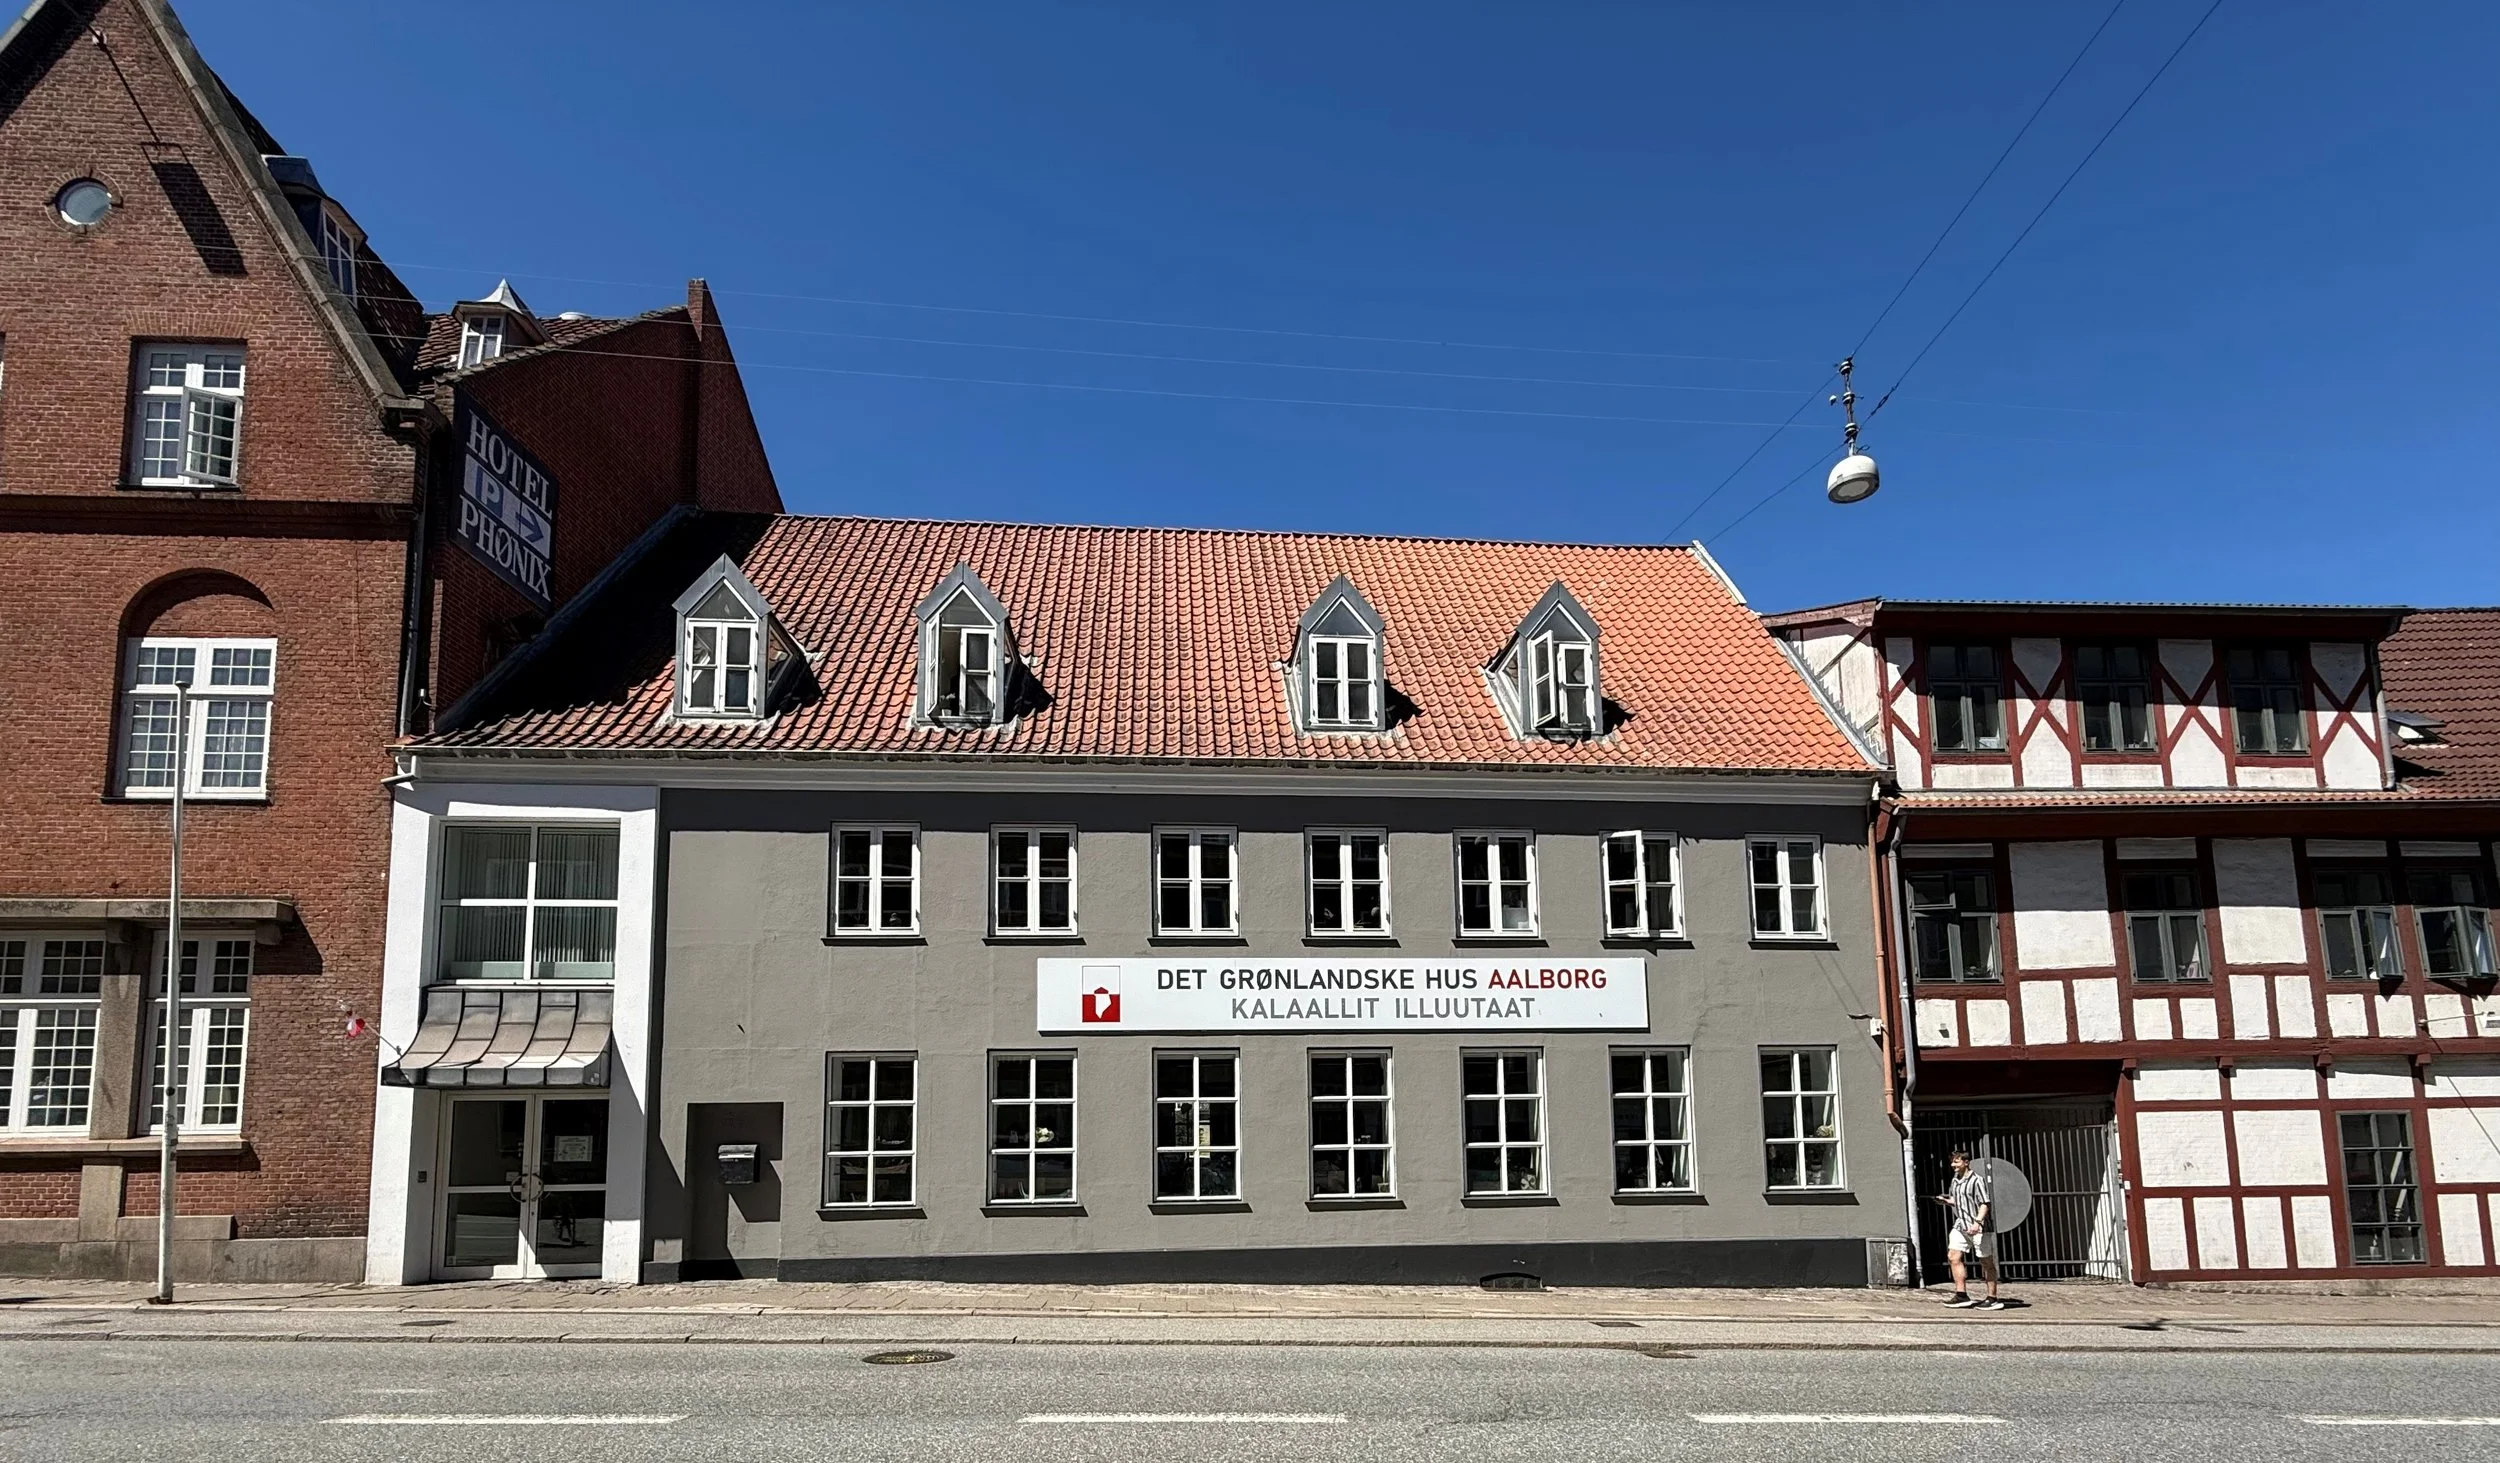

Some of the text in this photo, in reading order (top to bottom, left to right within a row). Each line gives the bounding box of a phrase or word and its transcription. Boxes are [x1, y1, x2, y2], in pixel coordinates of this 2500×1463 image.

[466, 408, 553, 520] HOTEL
[457, 494, 552, 602] PHØNIX
[1157, 968, 1608, 991] DET GRØNLANDSKE HUS AALBORG
[1231, 997, 1536, 1019] KALAALLIT ILLUUTAAT
